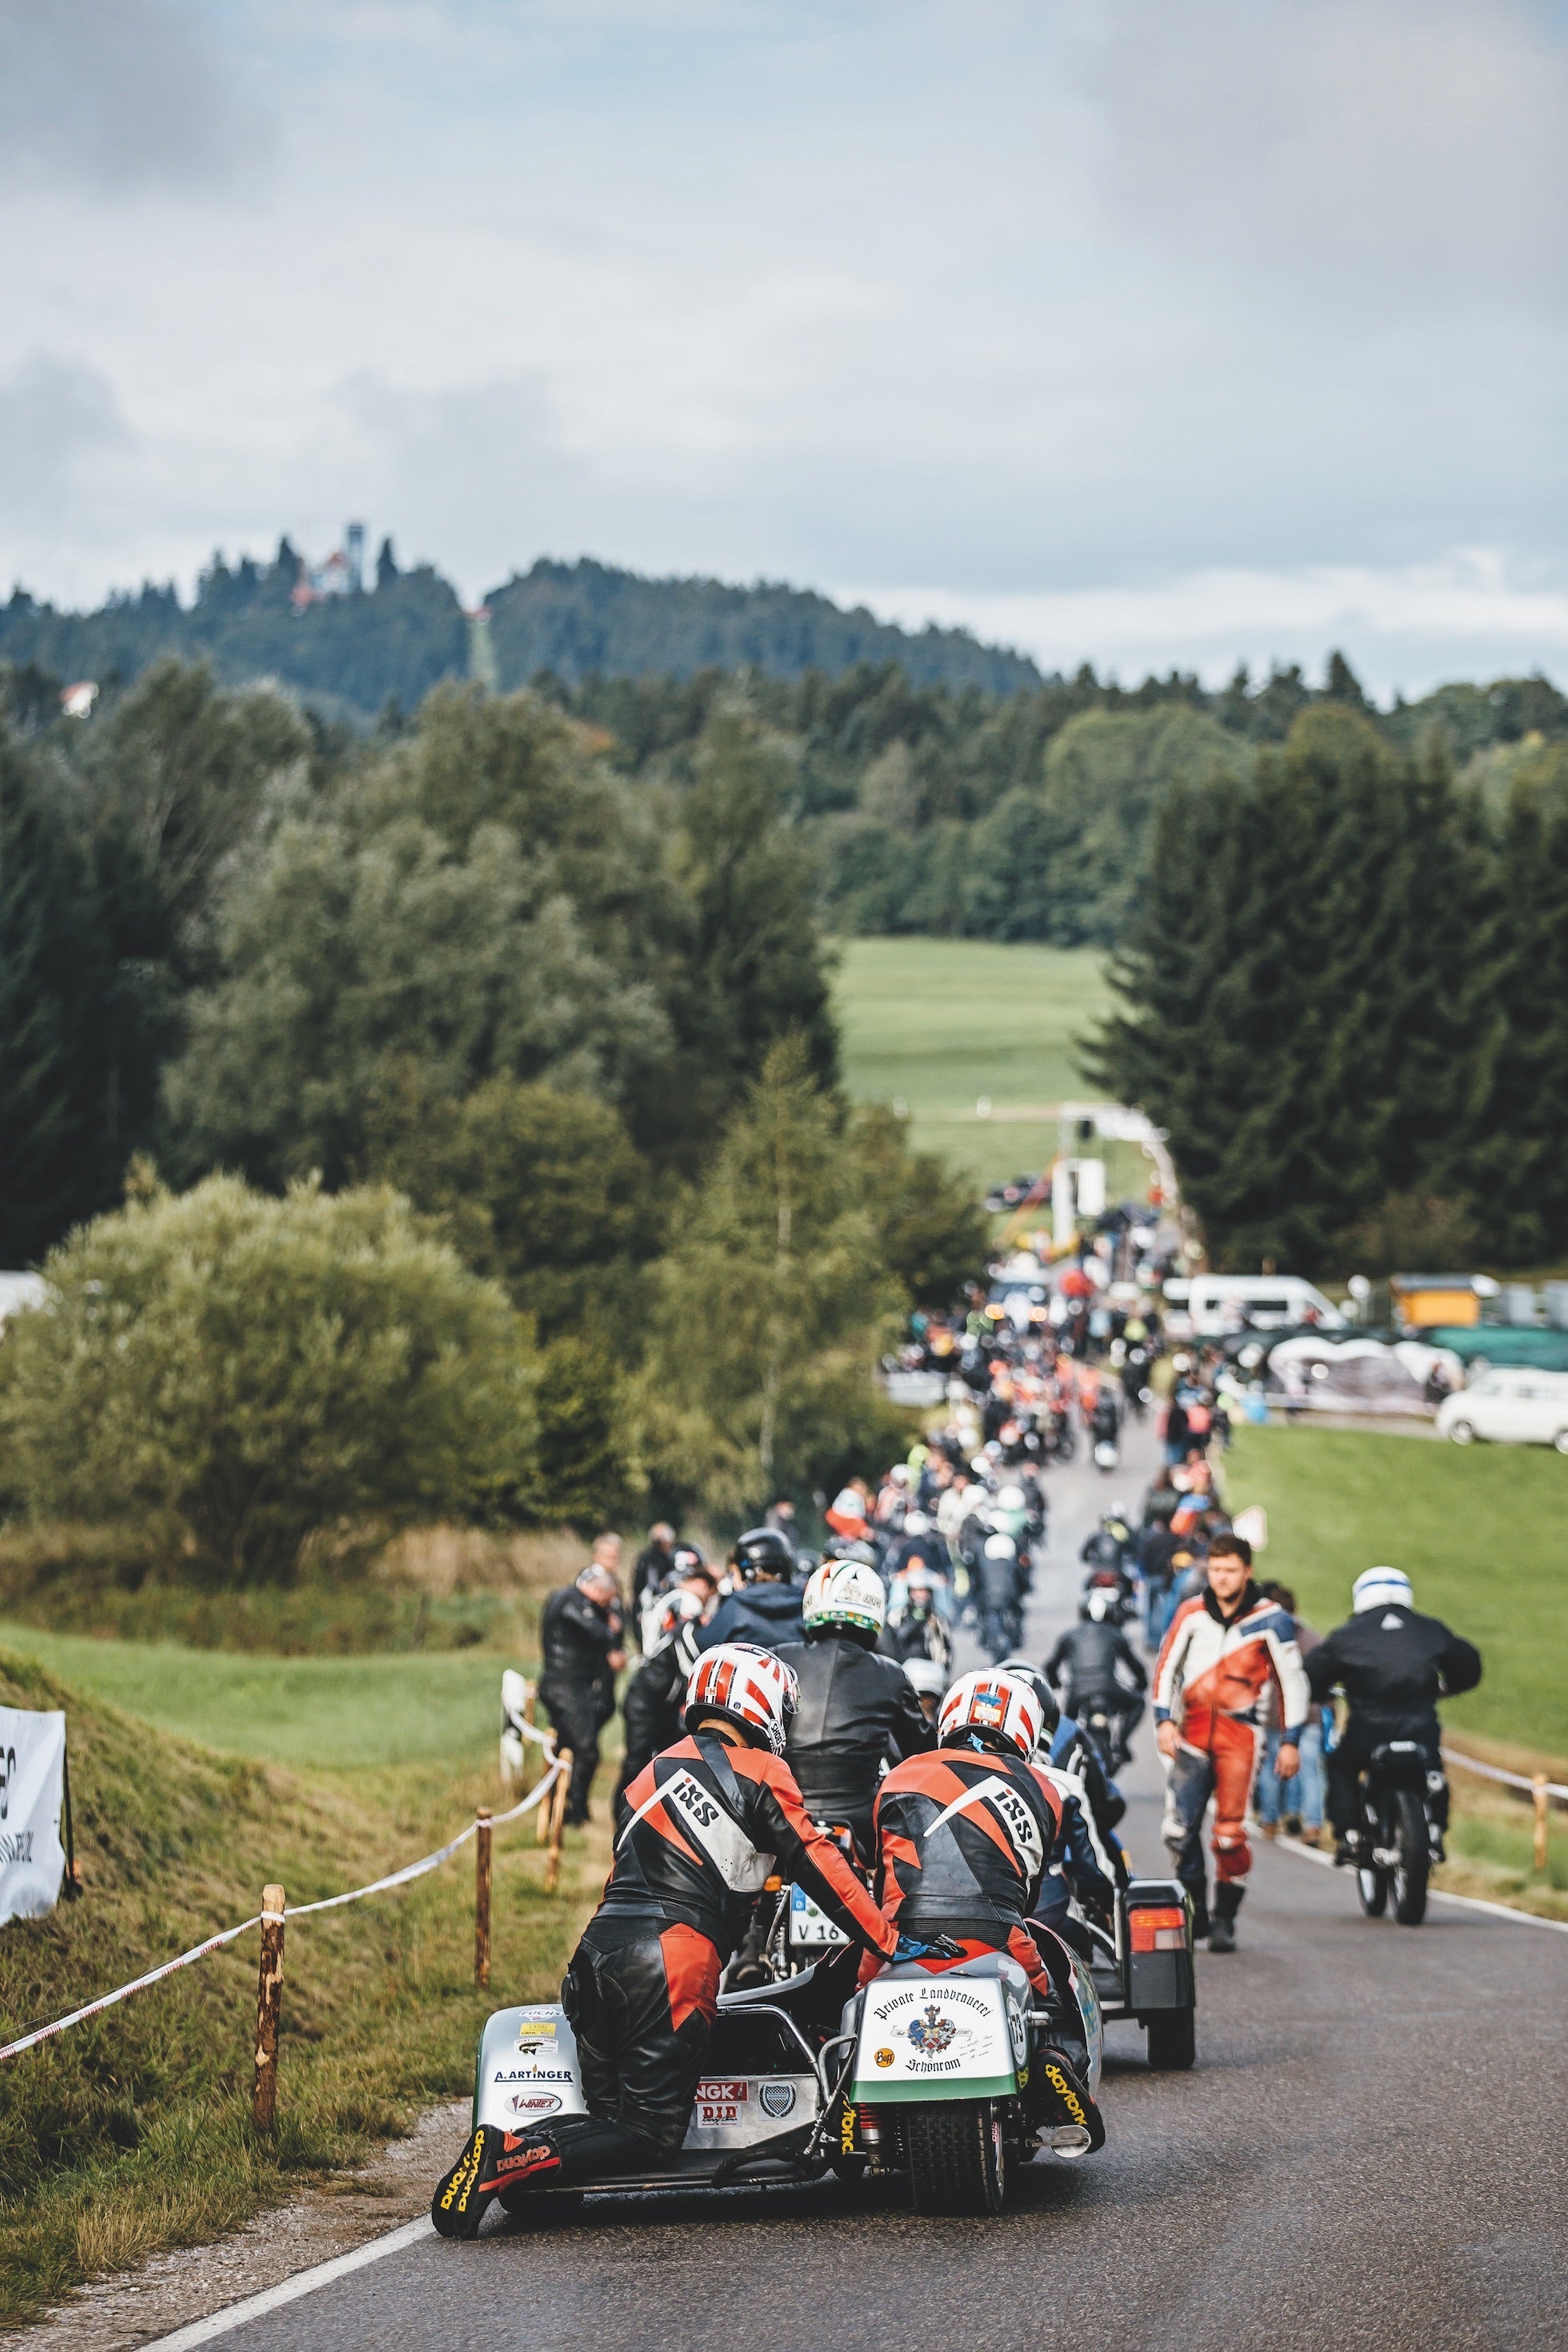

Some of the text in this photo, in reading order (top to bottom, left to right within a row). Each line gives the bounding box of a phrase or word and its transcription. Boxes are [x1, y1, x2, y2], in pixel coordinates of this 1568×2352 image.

[798, 1925, 808, 1940] V
[874, 1987, 994, 2020] Private Landbrauerei
[906, 2058, 961, 2074] Schönram
[694, 2084, 734, 2100] NGK
[1045, 2064, 1088, 2125] dayton
[458, 2130, 485, 2212] daytona
[497, 2145, 550, 2172] daytona
